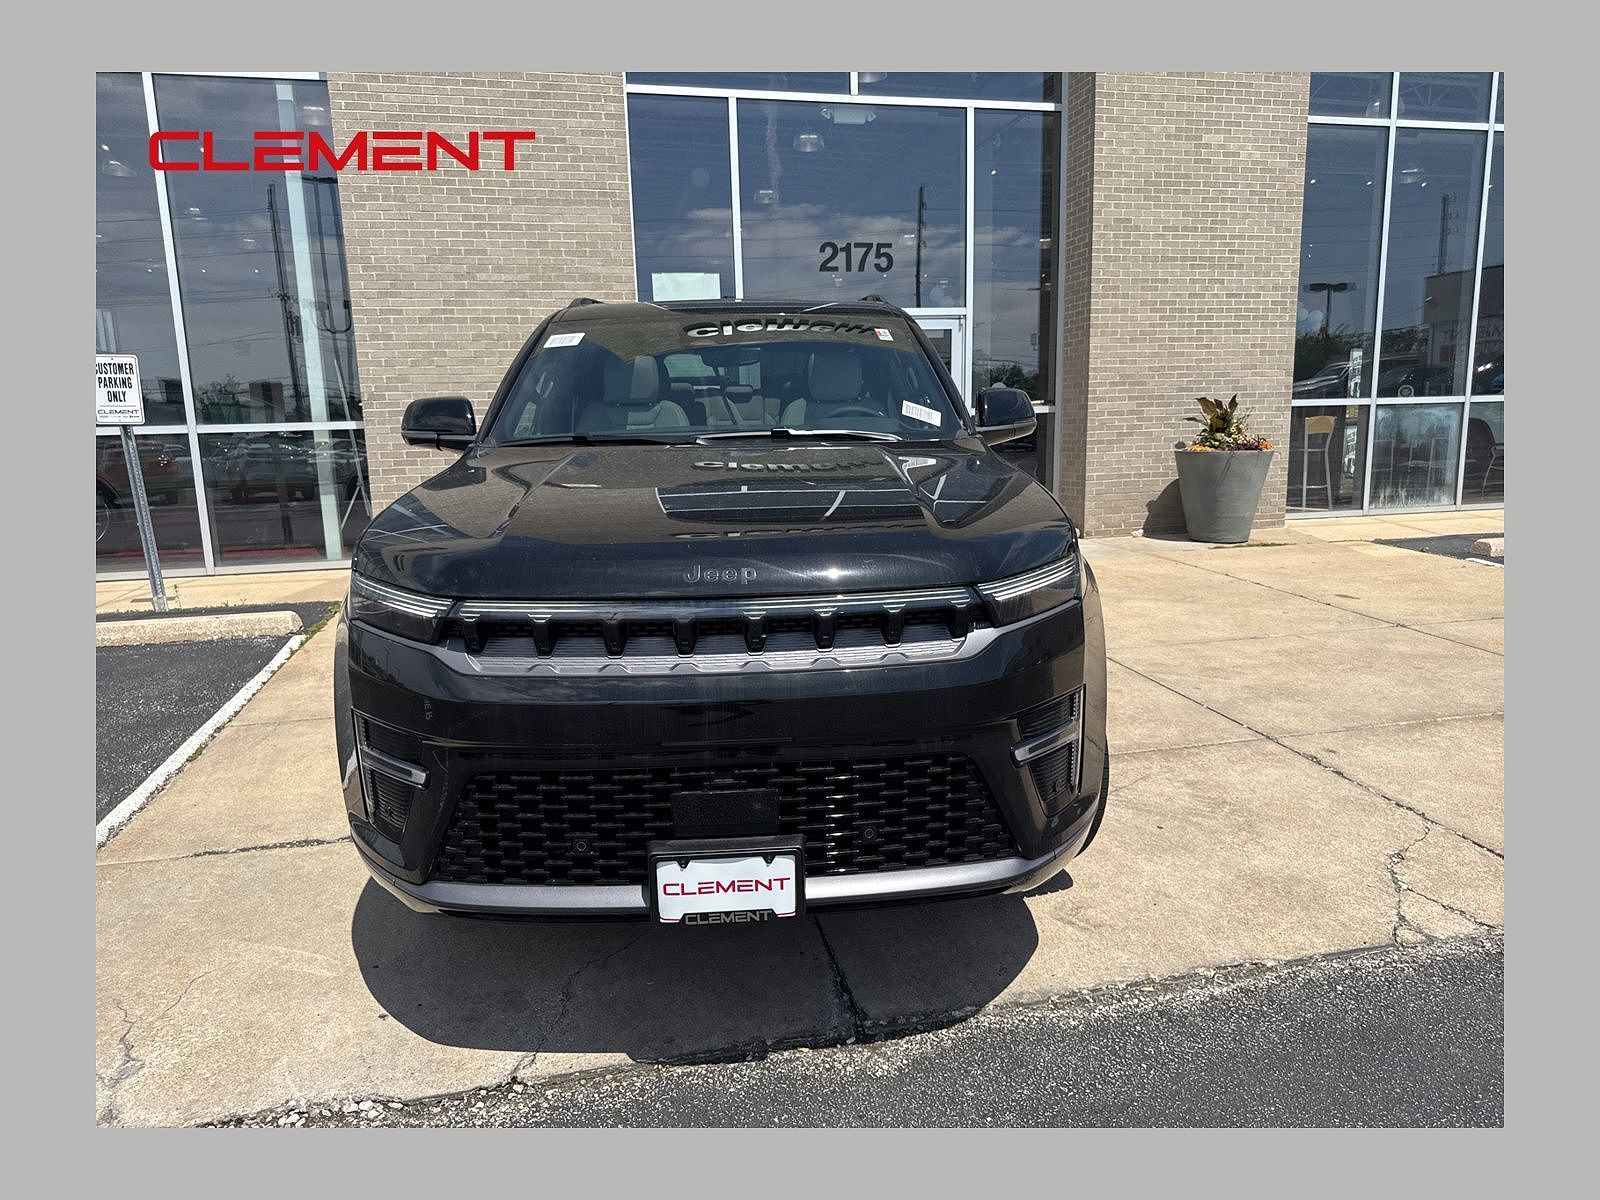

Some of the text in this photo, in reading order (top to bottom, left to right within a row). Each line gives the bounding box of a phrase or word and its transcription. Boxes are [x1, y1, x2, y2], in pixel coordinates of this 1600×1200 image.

[819, 242, 894, 272] 2175
[98, 377, 132, 389] PARKING
[107, 390, 126, 402] ONLY
[683, 564, 758, 584] Jeep
[662, 877, 791, 896] CLEMENT
[685, 910, 773, 925] CLEMENT
